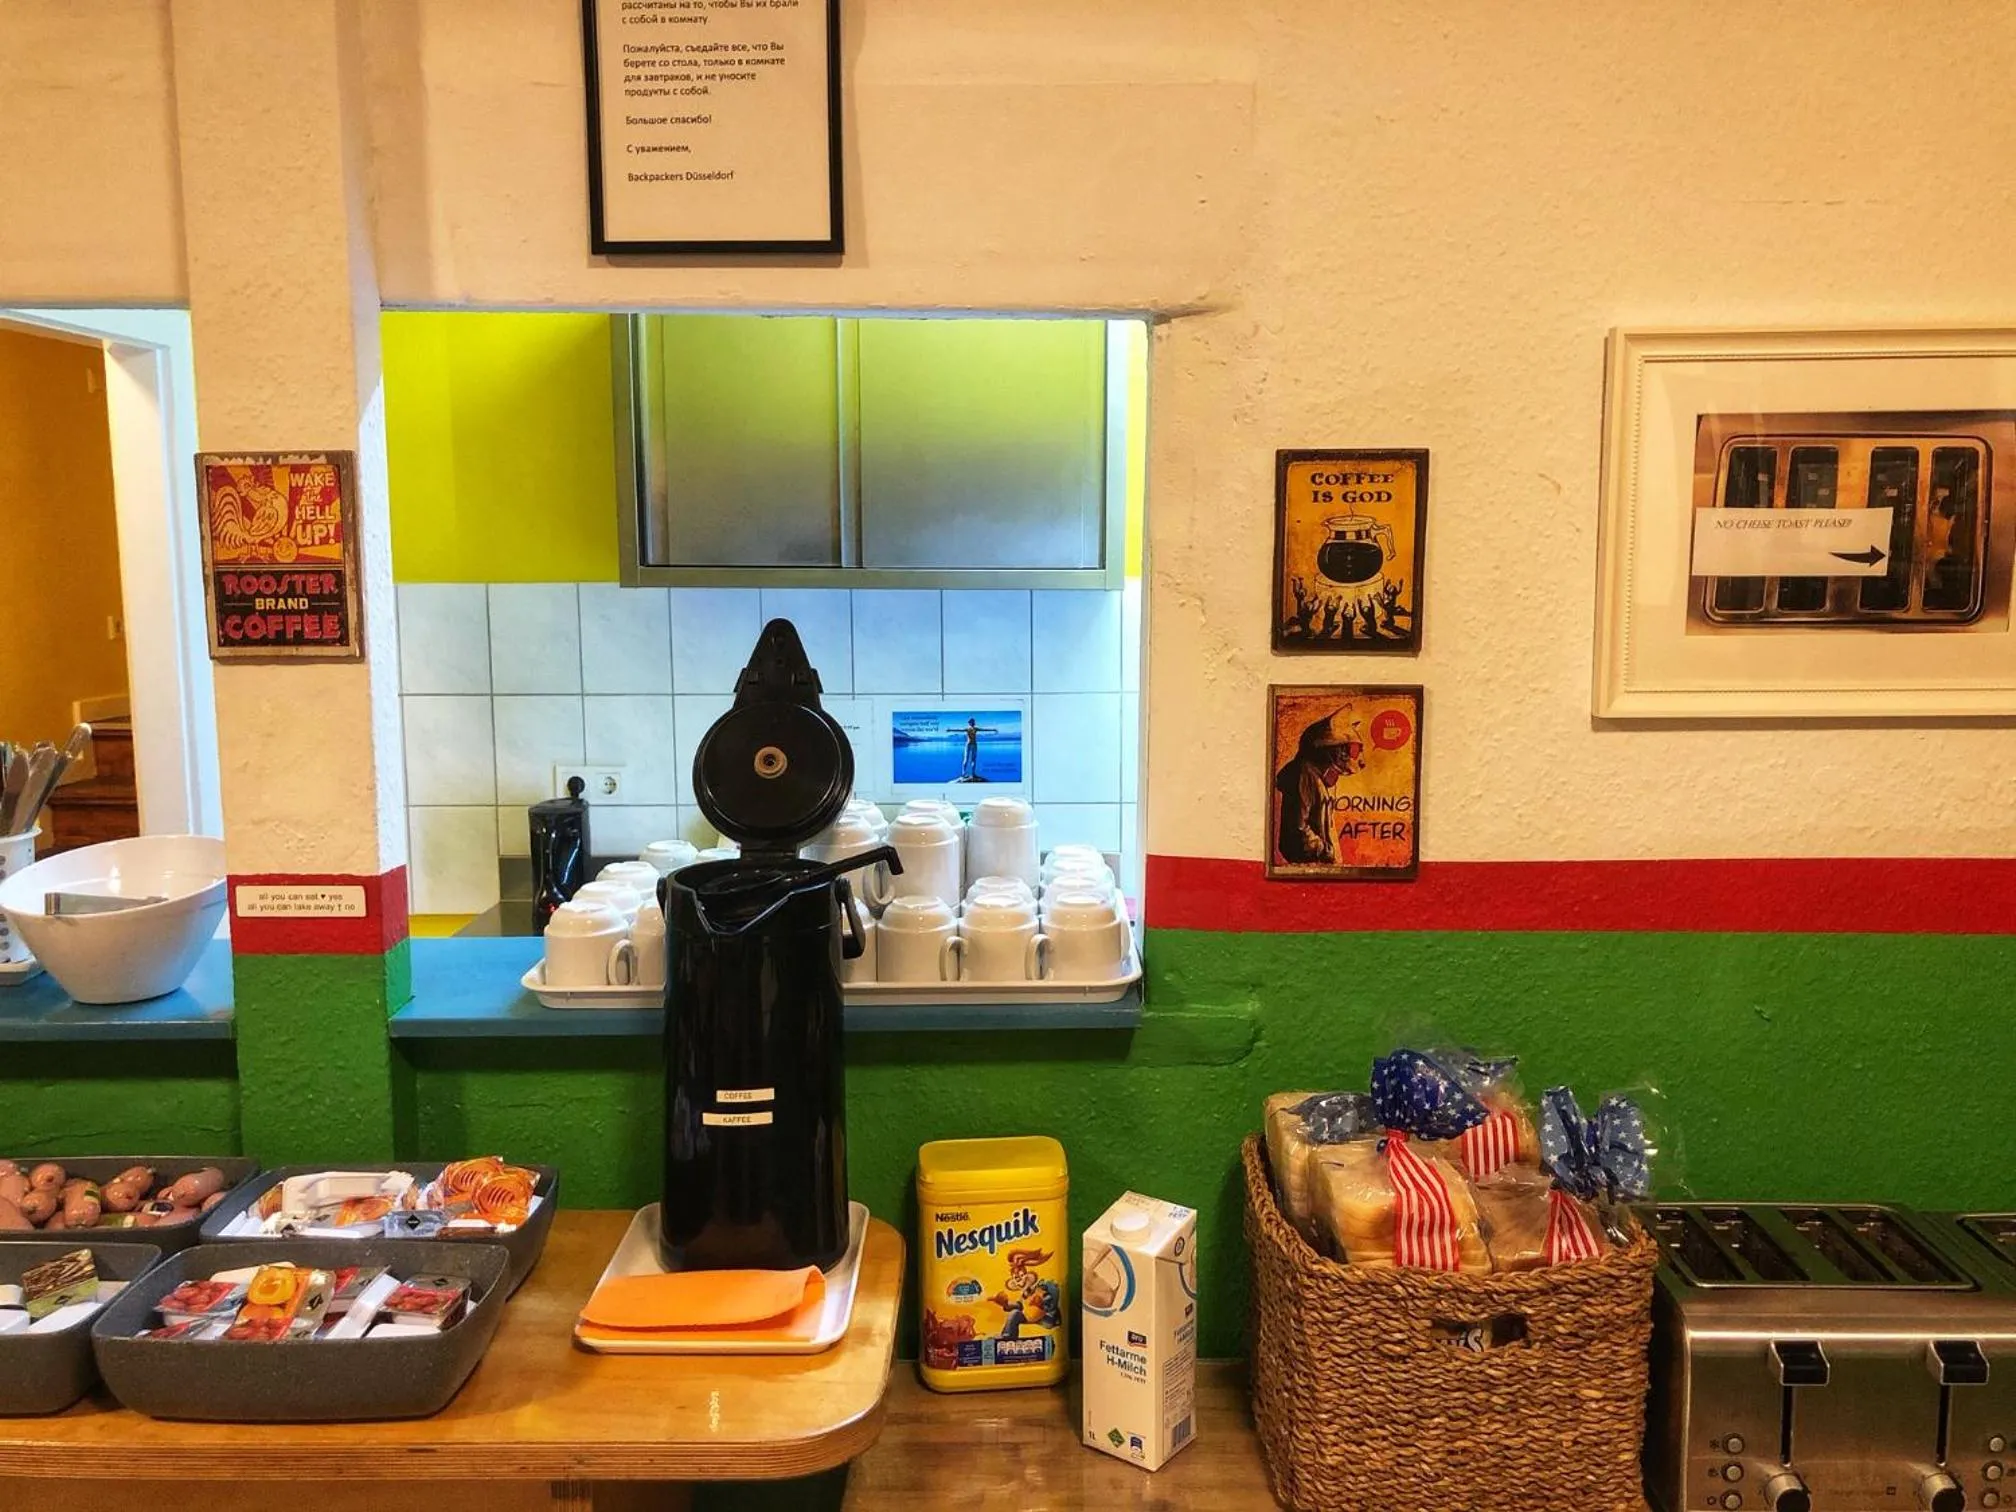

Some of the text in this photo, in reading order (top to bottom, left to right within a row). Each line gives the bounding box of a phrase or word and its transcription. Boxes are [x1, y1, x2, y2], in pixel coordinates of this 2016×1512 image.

[621, 1, 676, 10] рассчитаны
[680, 1, 690, 9] на
[693, 1, 706, 10] то,
[708, 0, 737, 8] чтобы
[756, 0, 767, 8] их
[621, 14, 708, 25] с собой в комнату
[731, 43, 750, 52] все,
[752, 43, 768, 51] что
[770, 42, 784, 51] Вы
[623, 58, 656, 69] берете
[704, 58, 736, 67] только
[745, 58, 785, 66] комнате
[624, 74, 641, 83] для
[705, 73, 717, 81] не
[719, 72, 756, 82] уносите
[624, 87, 670, 98] продукты
[673, 88, 678, 96] с
[625, 114, 712, 125] Большое спасибо!
[626, 144, 691, 155] С уважением,
[628, 170, 734, 182] Backpackers Düsseldorf
[290, 472, 335, 487] WAKE
[1310, 472, 1394, 486] COFFEE
[1312, 490, 1393, 503] IS GOD
[295, 505, 336, 520] HELL
[1714, 519, 1734, 529] NO
[1776, 518, 1813, 529] TOAST
[296, 523, 336, 546] UP!
[222, 573, 339, 596] ROOSTER
[255, 598, 309, 610] BRAND
[223, 613, 341, 640] COFFEE
[1321, 795, 1411, 813] MORNING
[1339, 822, 1406, 841] AFTER
[271, 894, 286, 902] you
[723, 1092, 752, 1100] COFFEE
[722, 1116, 752, 1124] KAFFEE
[935, 1207, 1040, 1259] Nesquik
[1099, 1339, 1147, 1365] Fettarme
[1106, 1355, 1147, 1377] H-Milch
